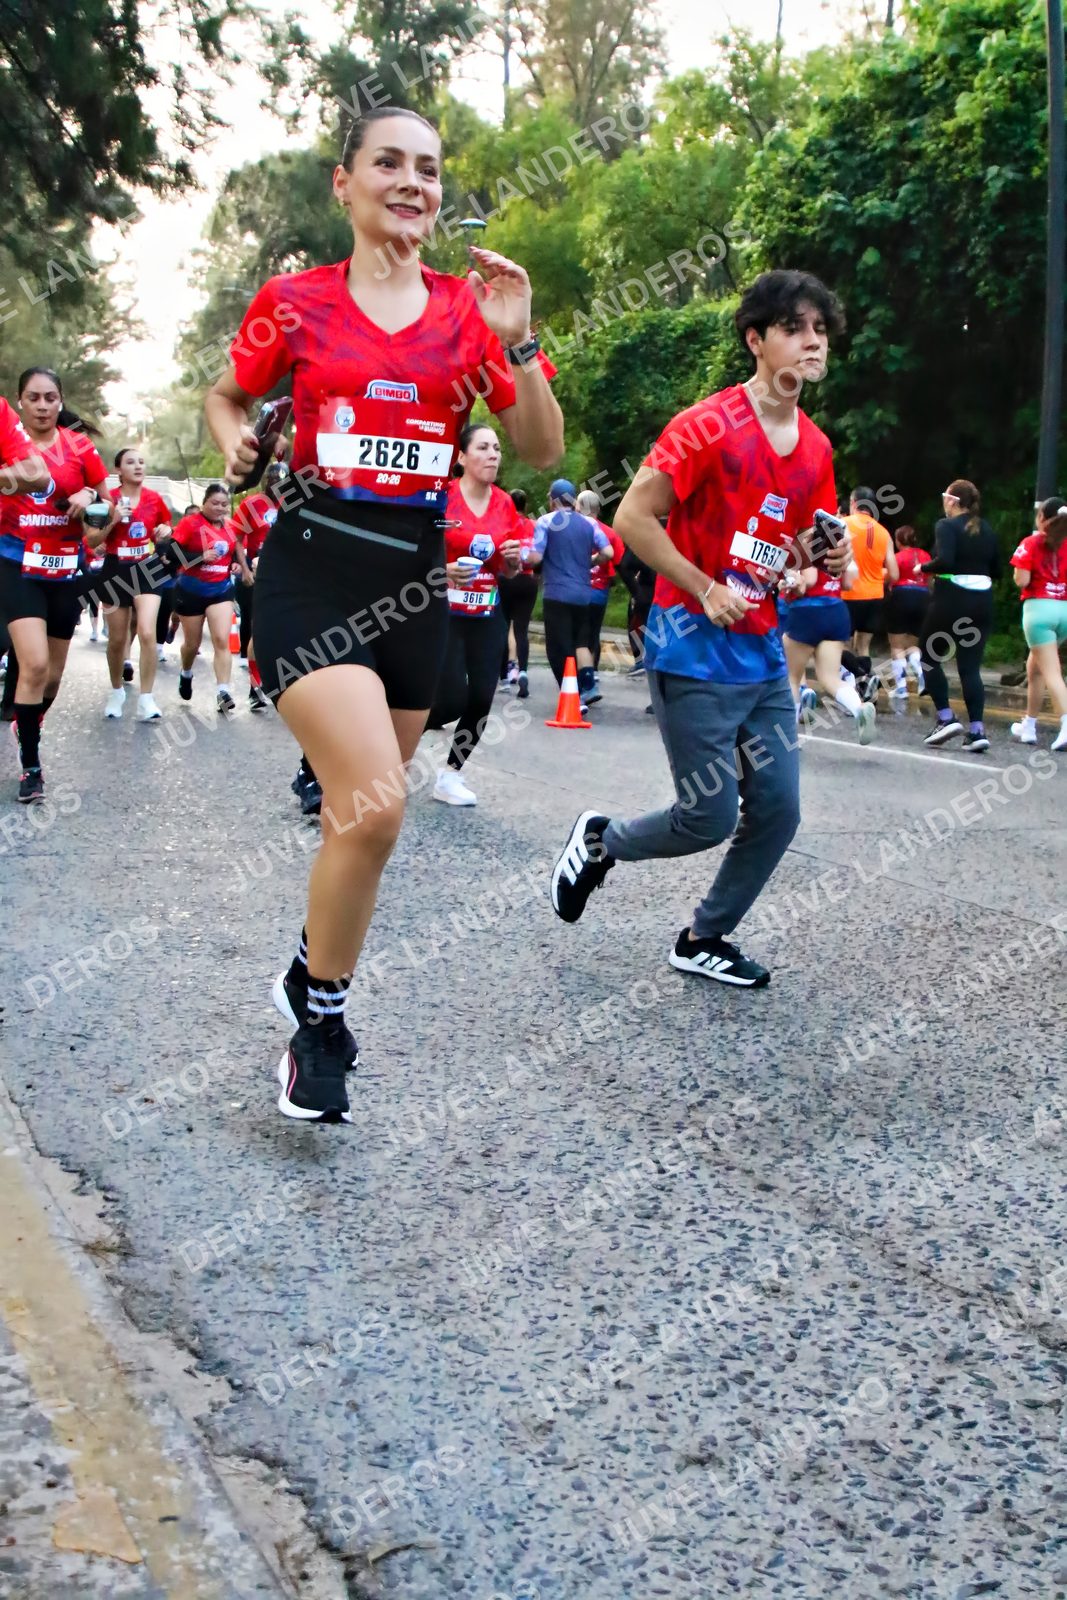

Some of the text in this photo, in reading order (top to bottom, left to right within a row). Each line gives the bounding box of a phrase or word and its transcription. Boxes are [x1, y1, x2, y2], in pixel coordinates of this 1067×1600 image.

[375, 387, 410, 400] BIMBO
[359, 437, 420, 471] 2626
[376, 472, 401, 485] 20-26
[425, 491, 437, 501] 5K
[19, 513, 69, 527] SANTIAGO
[751, 540, 782, 567] 17637
[41, 555, 64, 568] 2981
[463, 592, 484, 604] 3616
